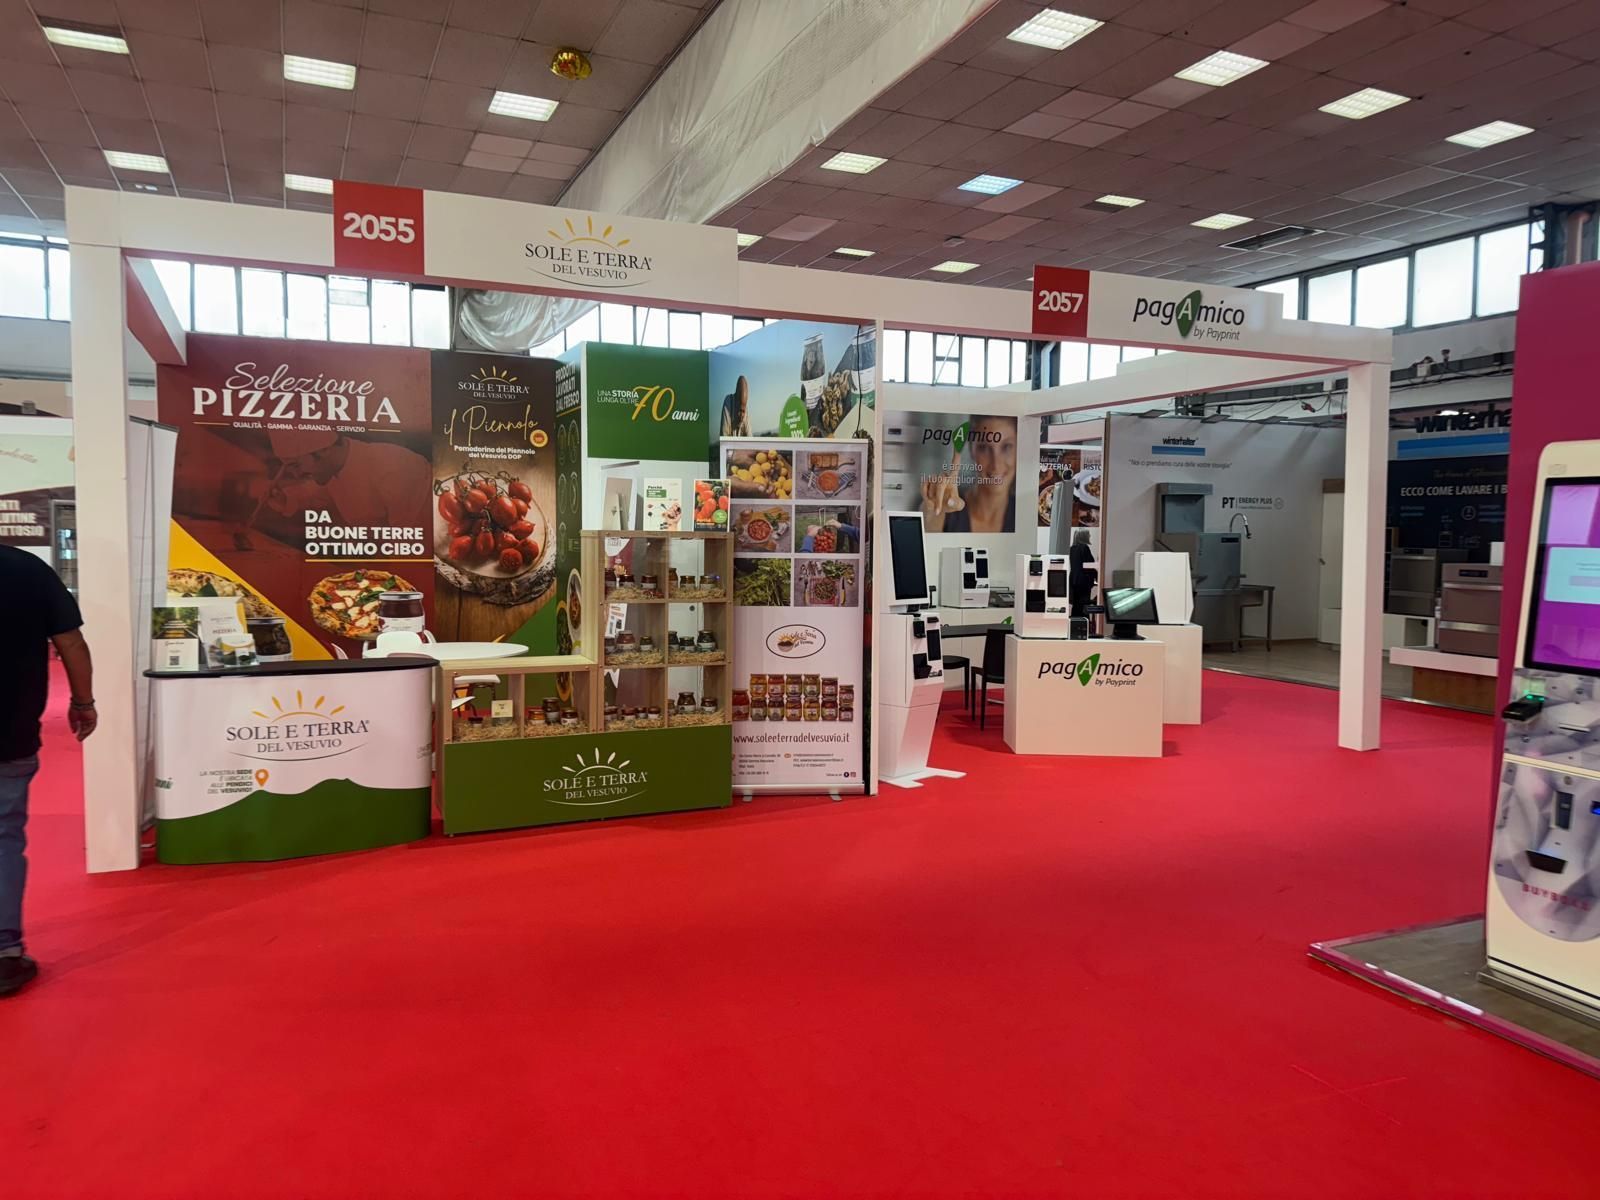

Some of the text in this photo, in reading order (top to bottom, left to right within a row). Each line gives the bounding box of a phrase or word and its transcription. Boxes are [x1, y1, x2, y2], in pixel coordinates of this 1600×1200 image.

[343, 212, 415, 243] 2055
[525, 243, 573, 262] SOLE
[578, 249, 590, 264] E
[552, 263, 628, 280] DEL VESUVIO
[1038, 290, 1084, 314] 2057
[1133, 295, 1245, 328] pagAmico
[1194, 327, 1240, 342] by Payprint
[225, 362, 375, 395] Selezione
[458, 381, 485, 392] SOLE
[487, 384, 494, 392] E
[611, 390, 639, 398] STORIA
[193, 387, 400, 423] PIZZERIA
[631, 385, 700, 421] 70 anni
[232, 421, 262, 429] QUALITÀ
[298, 424, 332, 432] GARANZIA
[336, 425, 366, 433] SERVIZIO
[443, 404, 538, 447] il Piennolo
[923, 425, 1002, 447] pagAmico
[454, 445, 495, 454] Pomodorino
[496, 446, 506, 454] del
[949, 461, 983, 472] arrivato
[928, 474, 943, 484] tuo
[977, 476, 1003, 485] amico
[1401, 487, 1425, 497] ECCO
[1426, 486, 1453, 496] COME
[1455, 484, 1493, 496] LAVARE
[1222, 496, 1235, 509] PT
[305, 510, 332, 523] DA
[305, 526, 424, 540] BUONE TERRE
[305, 542, 425, 556] OTTIMO CIBO
[1037, 657, 1144, 682] pagAmico
[1094, 678, 1136, 688] by Payprint
[226, 725, 279, 741] SOLE
[285, 724, 299, 739] E
[732, 731, 850, 744] www.soleeterradelvesuvio.it
[257, 738, 342, 753] DEL VESUVIO
[543, 778, 583, 792] SOLE
[586, 776, 597, 788] E
[565, 786, 628, 800] DEL VESUVIO
